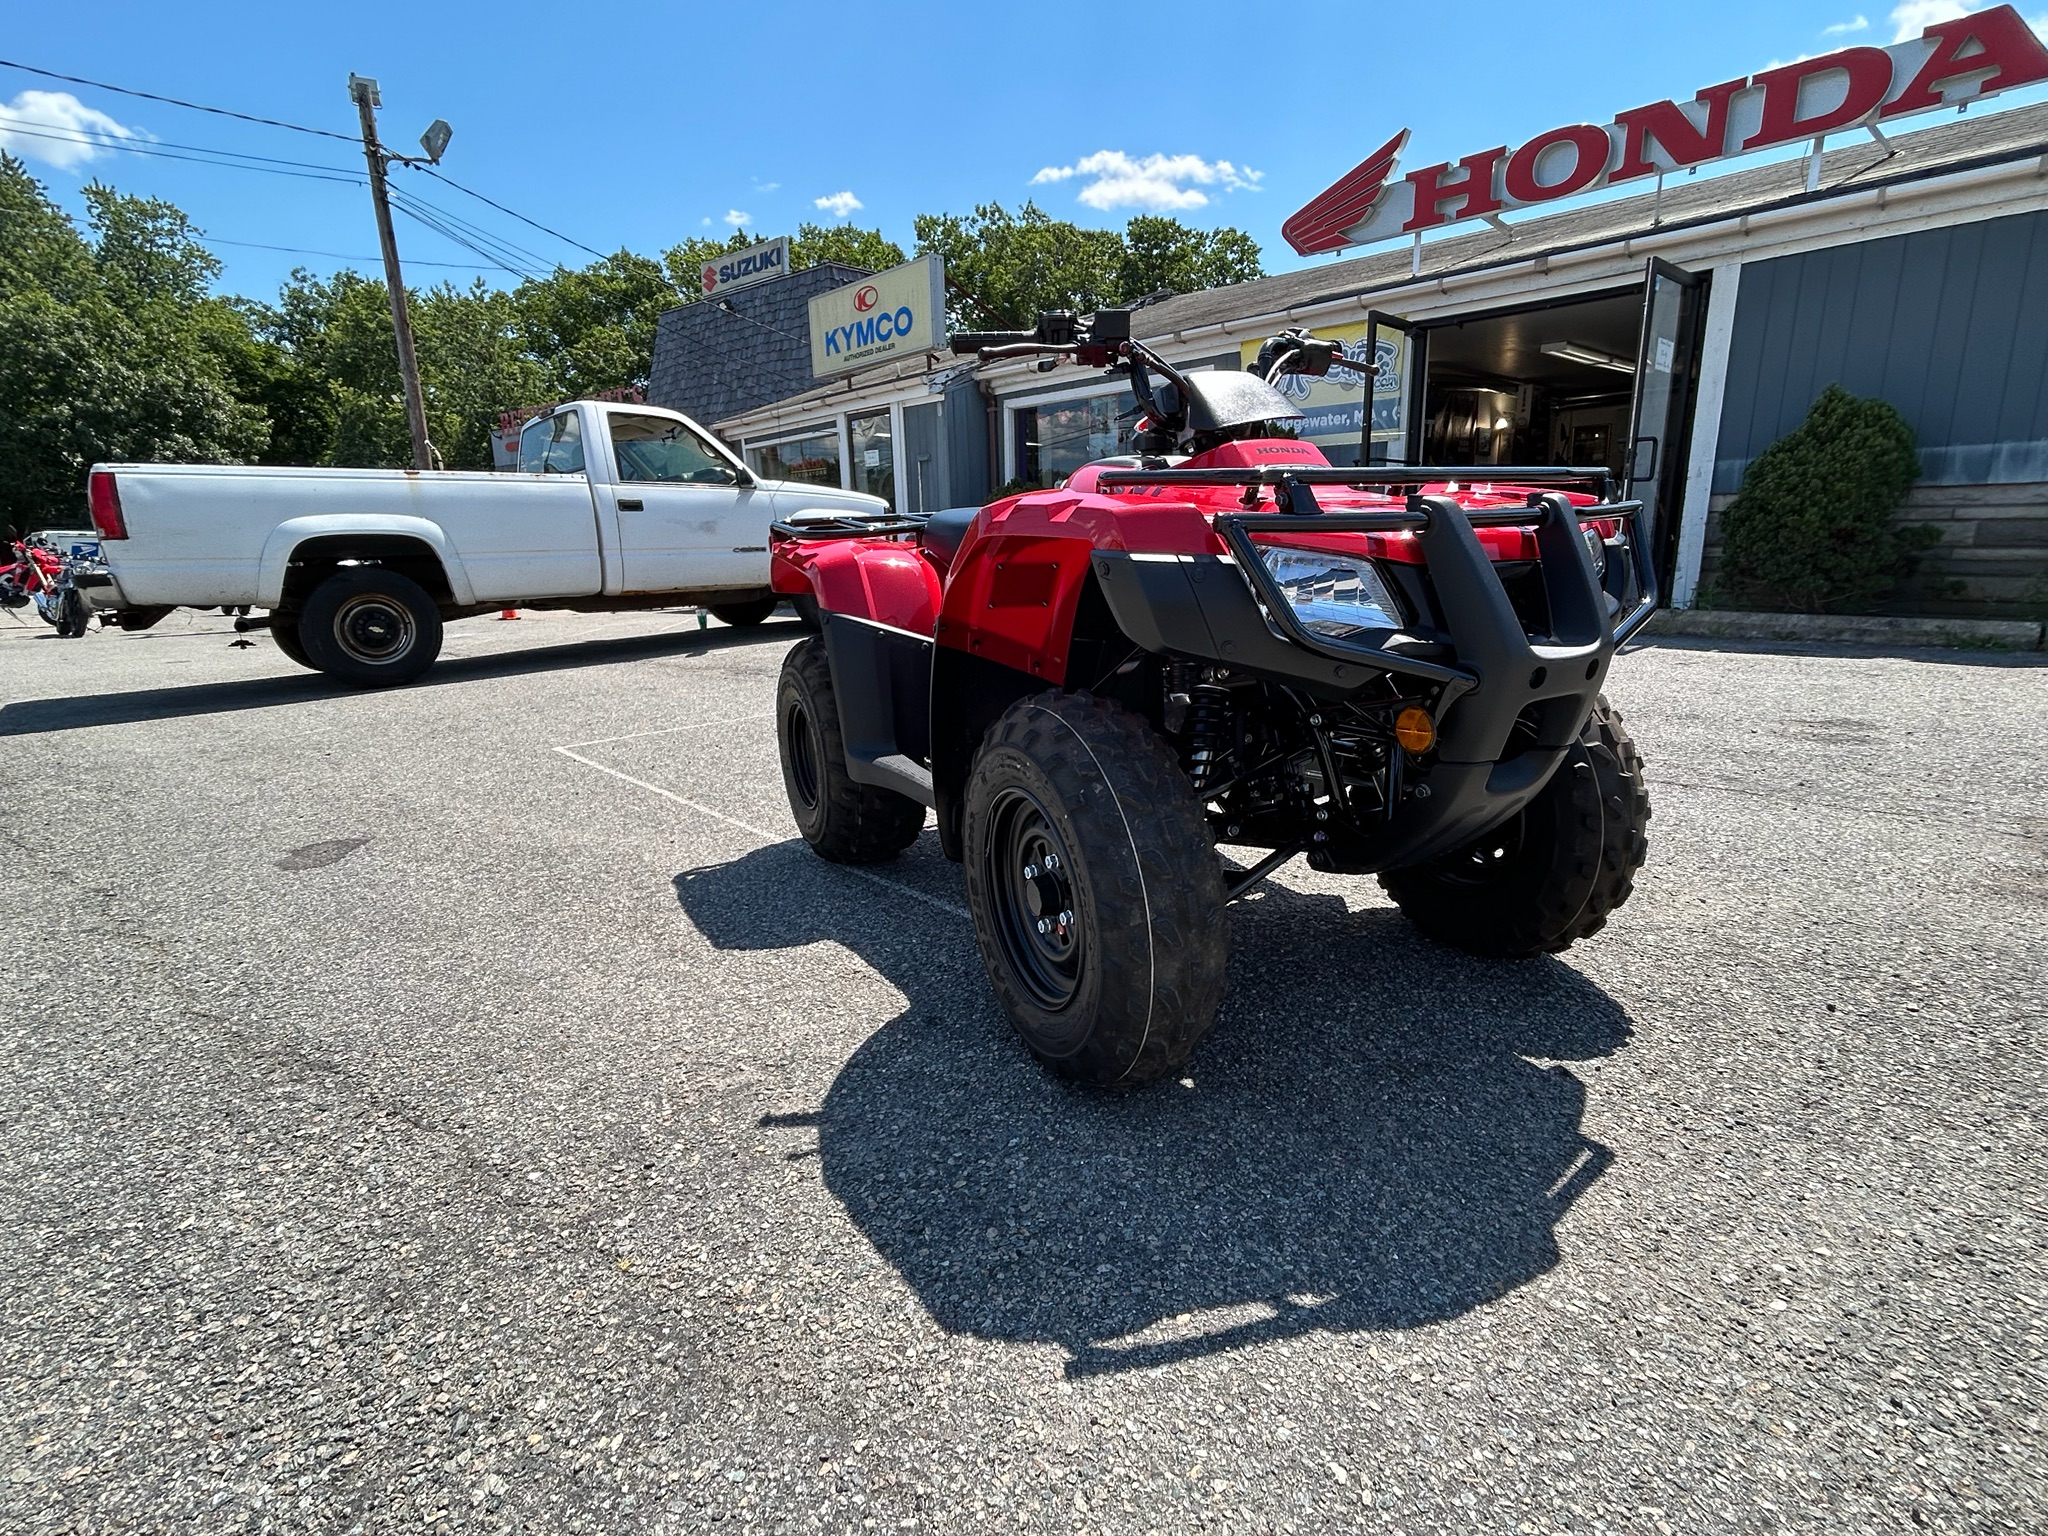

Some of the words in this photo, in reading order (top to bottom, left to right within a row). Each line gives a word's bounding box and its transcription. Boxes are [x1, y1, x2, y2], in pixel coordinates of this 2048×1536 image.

[1403, 4, 2048, 232] HONDA
[719, 246, 781, 284] SUZUKI
[825, 306, 913, 357] KYMCO
[844, 348, 875, 362] AUTHORIZED
[875, 342, 896, 354] DEALER
[1269, 411, 1350, 433] ridgewater,
[1256, 446, 1311, 455] HONDA
